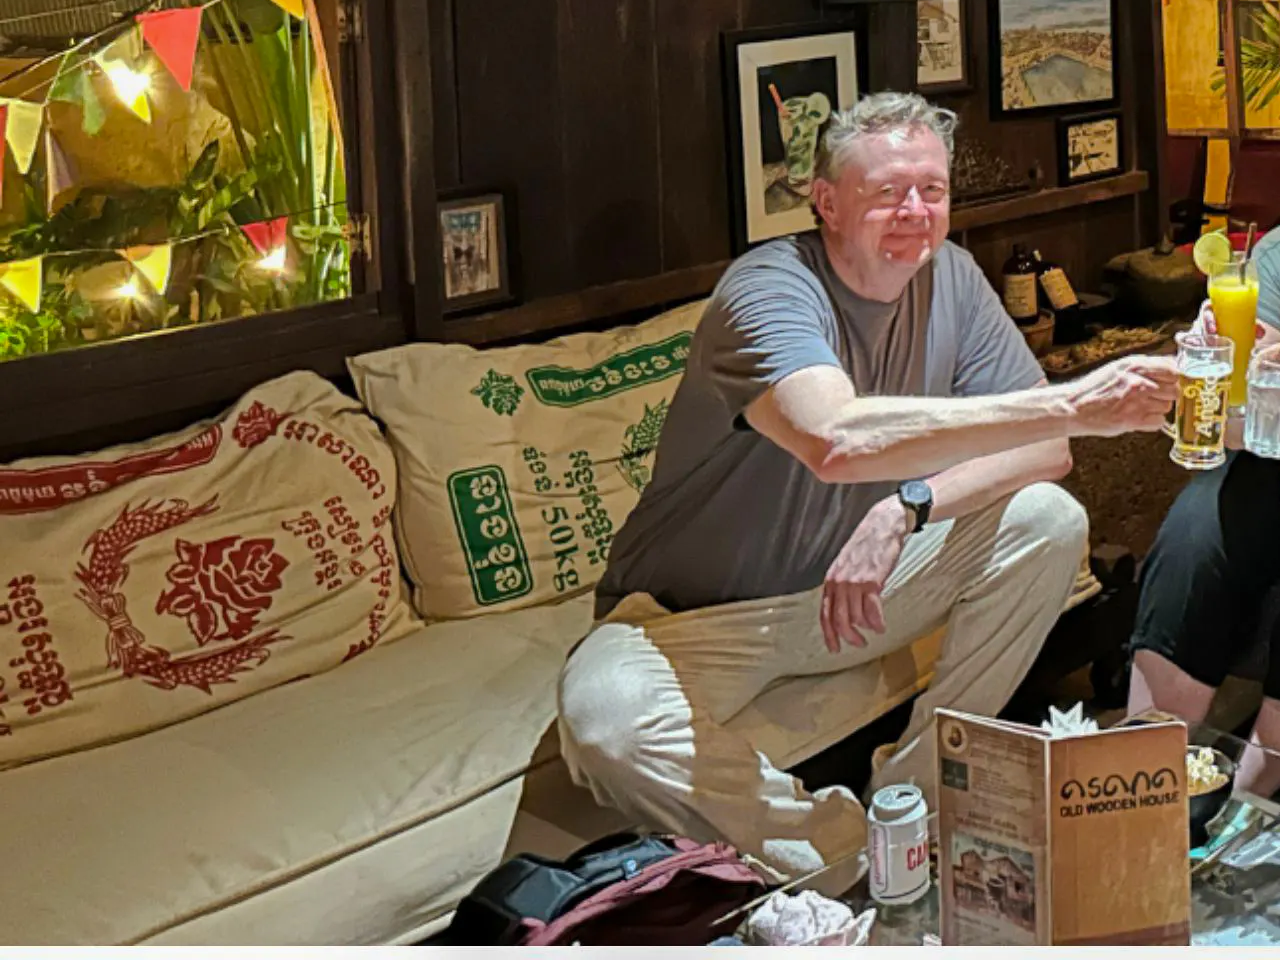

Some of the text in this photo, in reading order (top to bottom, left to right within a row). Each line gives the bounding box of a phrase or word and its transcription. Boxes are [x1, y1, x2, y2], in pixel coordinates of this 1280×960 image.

[541, 505, 579, 592] 50kg
[1060, 790, 1180, 818] OLD WOODEN HOUSE
